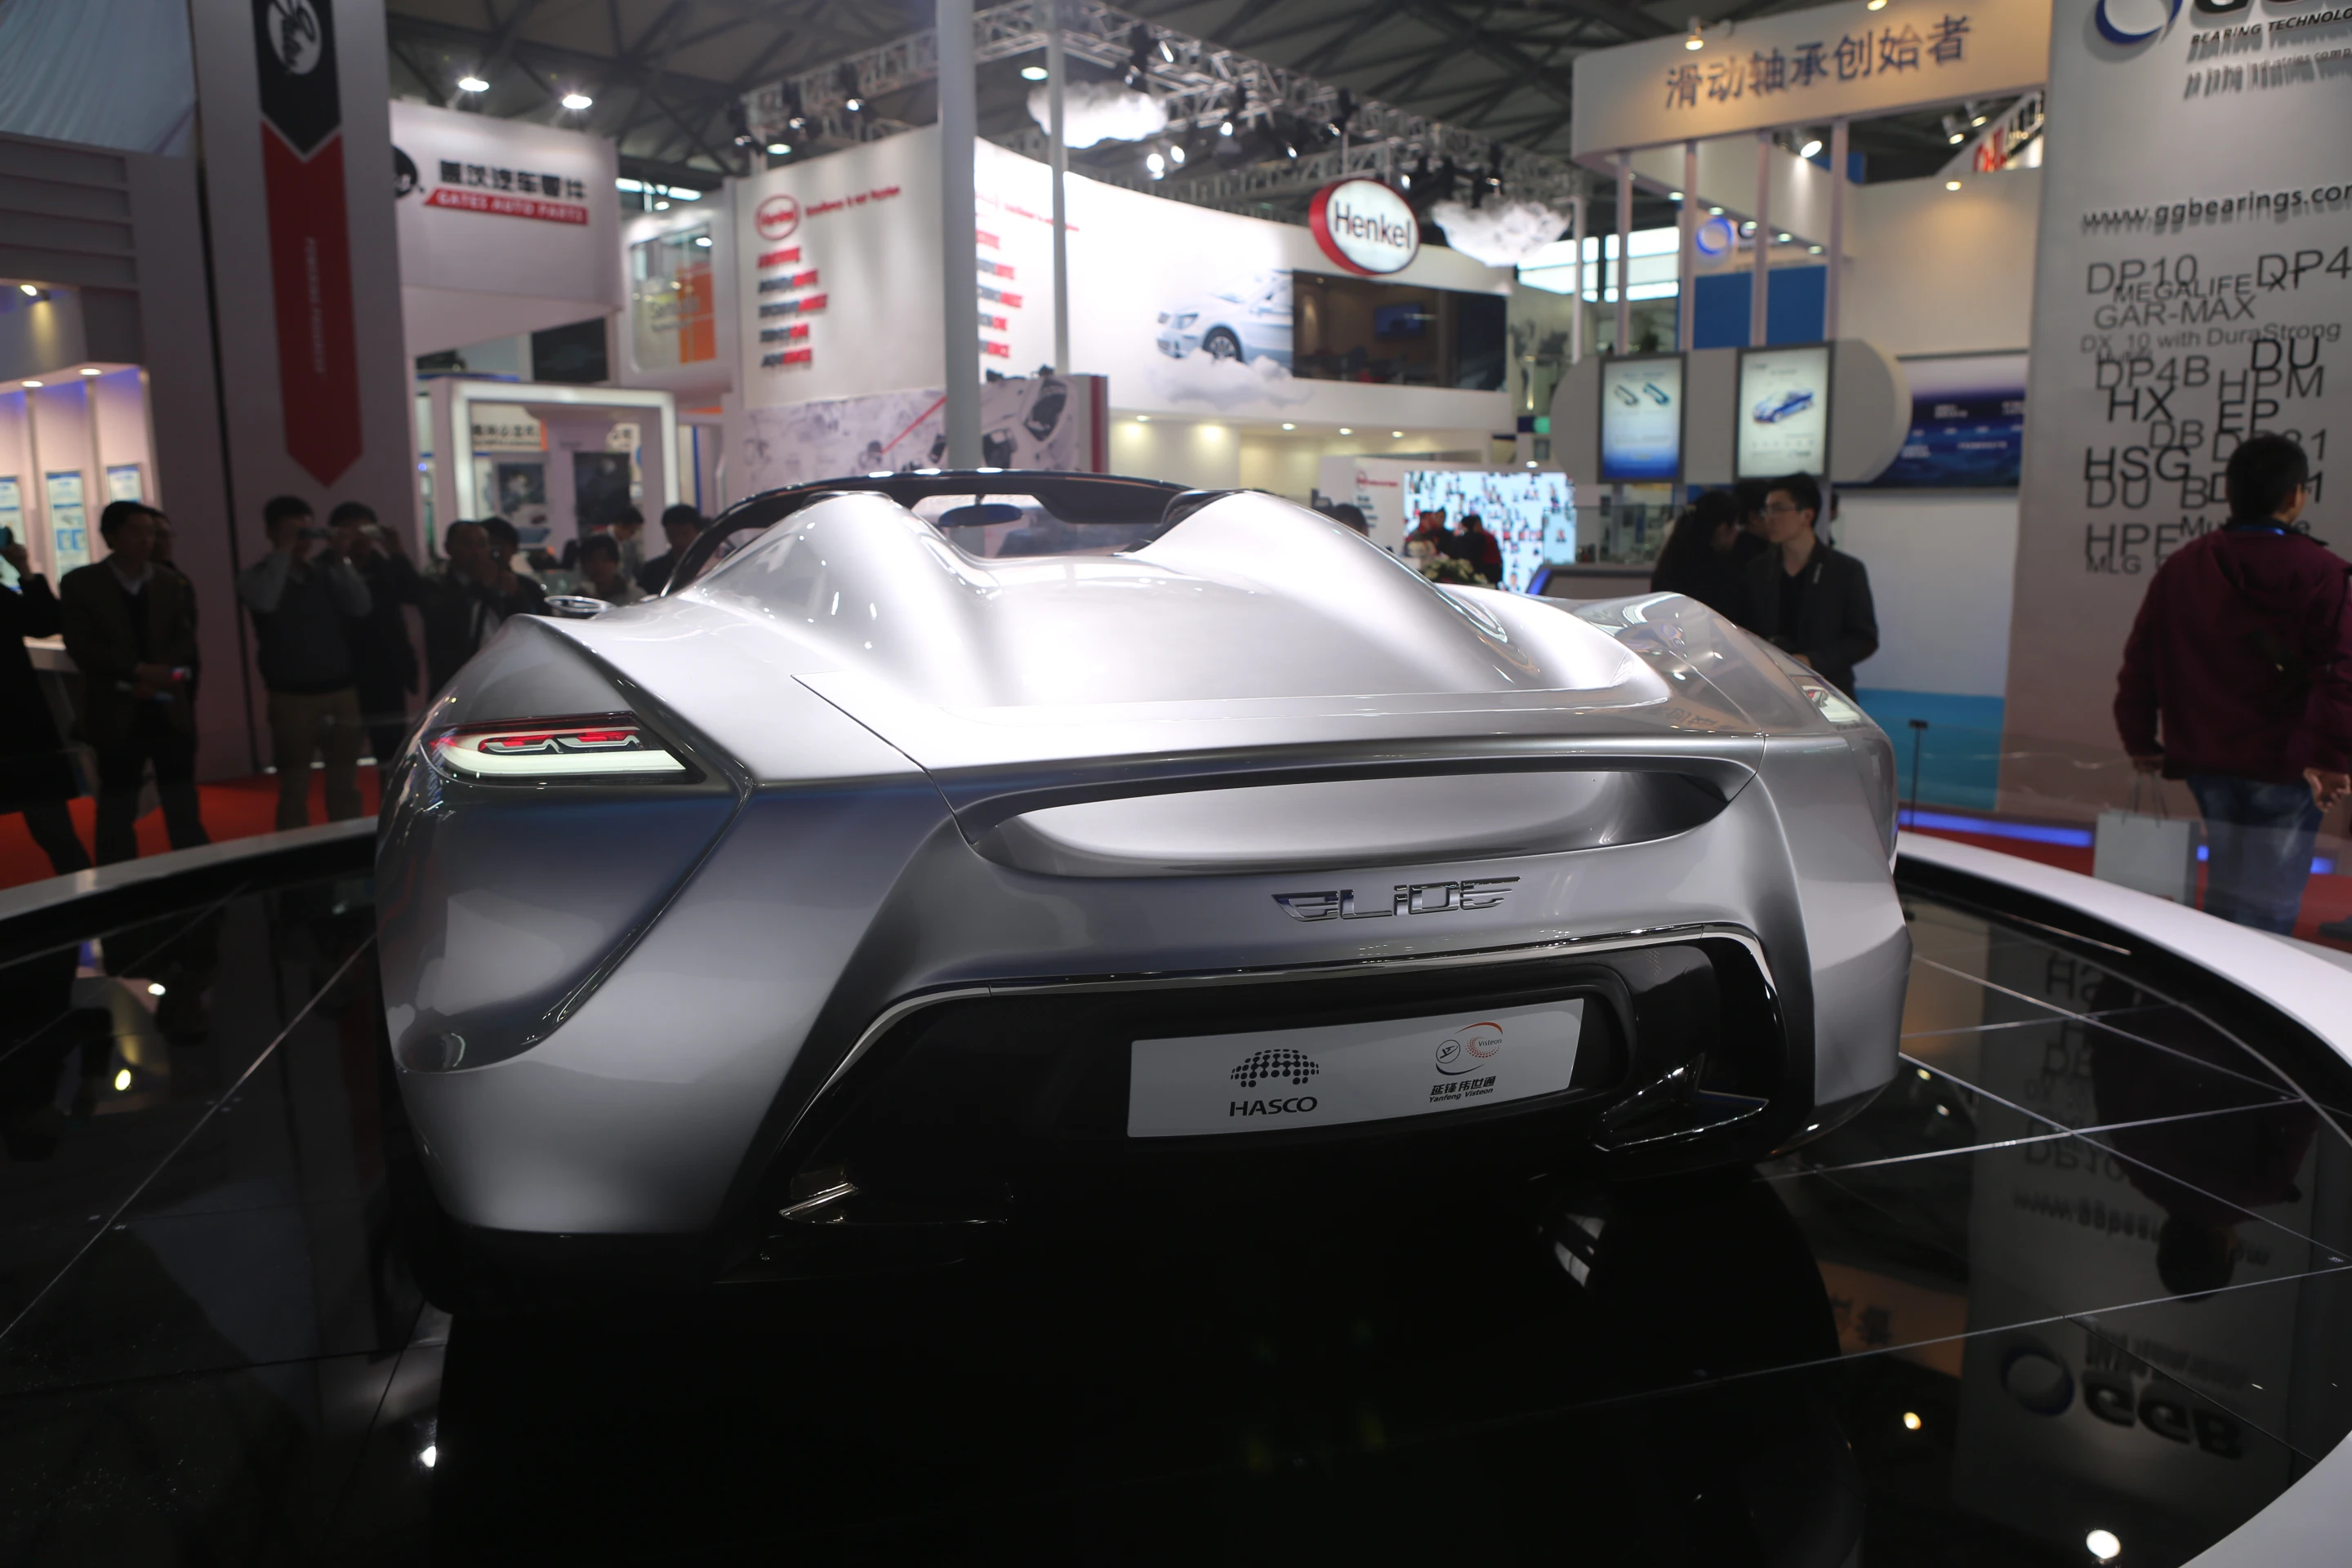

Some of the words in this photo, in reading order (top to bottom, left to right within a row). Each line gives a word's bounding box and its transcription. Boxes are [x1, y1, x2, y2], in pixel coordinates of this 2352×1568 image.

[2191, 24, 2261, 46] BEARING
[1665, 13, 1970, 109] 滑动轴承创始者
[1334, 200, 1411, 250] Henkel
[2087, 253, 2198, 294] DP10
[2113, 273, 2252, 302] MEGALIFE
[2093, 293, 2256, 330] GAR-MAX
[2156, 328, 2201, 349] with
[2250, 335, 2320, 372] DU
[2095, 354, 2211, 390] DP4B
[2107, 386, 2176, 422] HX
[2217, 399, 2279, 434] EP
[2149, 419, 2204, 449] DB
[2084, 446, 2191, 483] HSG
[1478, 1038, 1503, 1047] Visteon
[1429, 1094, 1461, 1103] Yanfeng
[1465, 1088, 1494, 1098] Visteon
[1430, 1076, 1496, 1096] 延锋伟世通
[1229, 1097, 1318, 1116] HASCO
